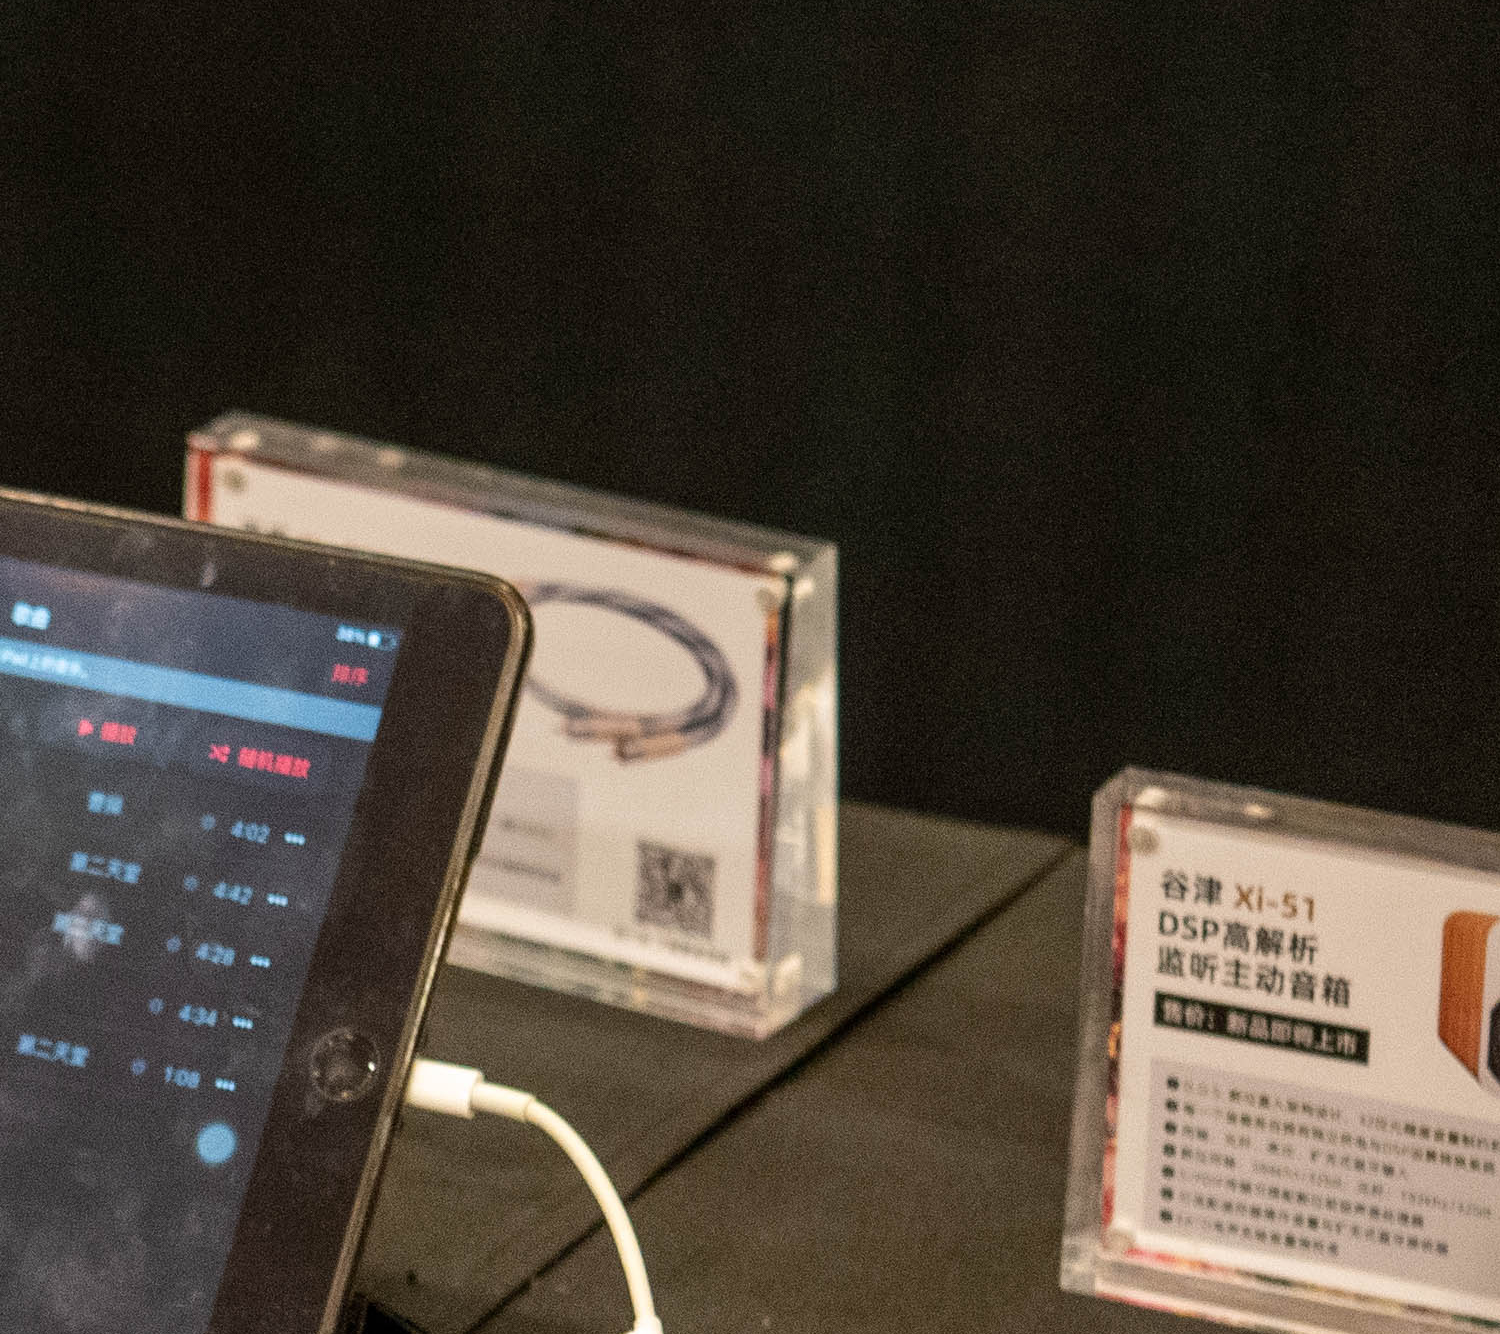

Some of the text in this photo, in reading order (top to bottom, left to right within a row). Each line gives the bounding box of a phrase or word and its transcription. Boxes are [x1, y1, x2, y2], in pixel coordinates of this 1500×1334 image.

[230, 820, 271, 845] 4:02
[212, 881, 254, 906] 4:42
[1161, 869, 1315, 922] 谷津 Xi-51
[1158, 910, 1317, 965] DSP高解析
[1156, 945, 1350, 1008] 监听主动音箱
